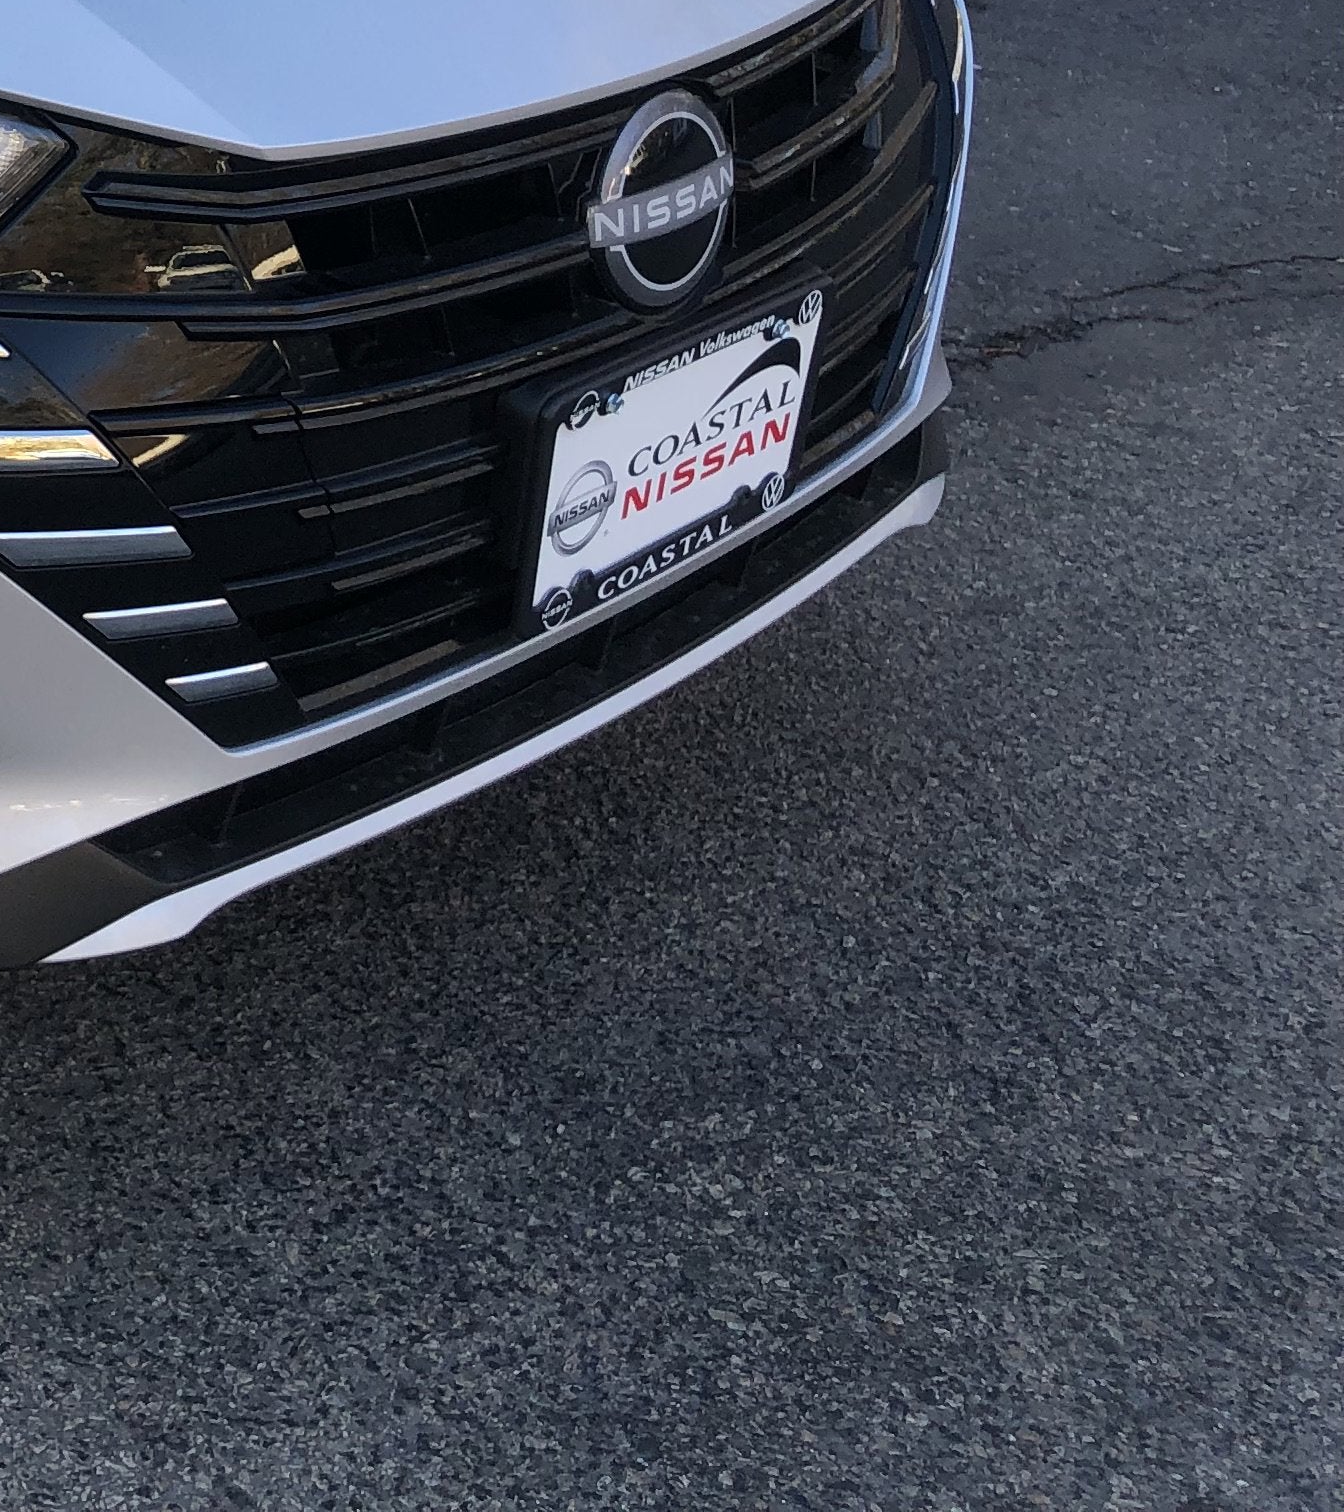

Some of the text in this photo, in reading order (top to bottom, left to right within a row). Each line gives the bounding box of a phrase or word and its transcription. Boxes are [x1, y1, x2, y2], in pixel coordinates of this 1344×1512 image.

[594, 158, 734, 241] NISSAN
[623, 315, 775, 394] NISSAN Volkswagen
[621, 412, 791, 520] NISSAN
[628, 380, 795, 477] COASTAL
[553, 490, 610, 529] NISSAN
[597, 514, 733, 600] COASTAL
